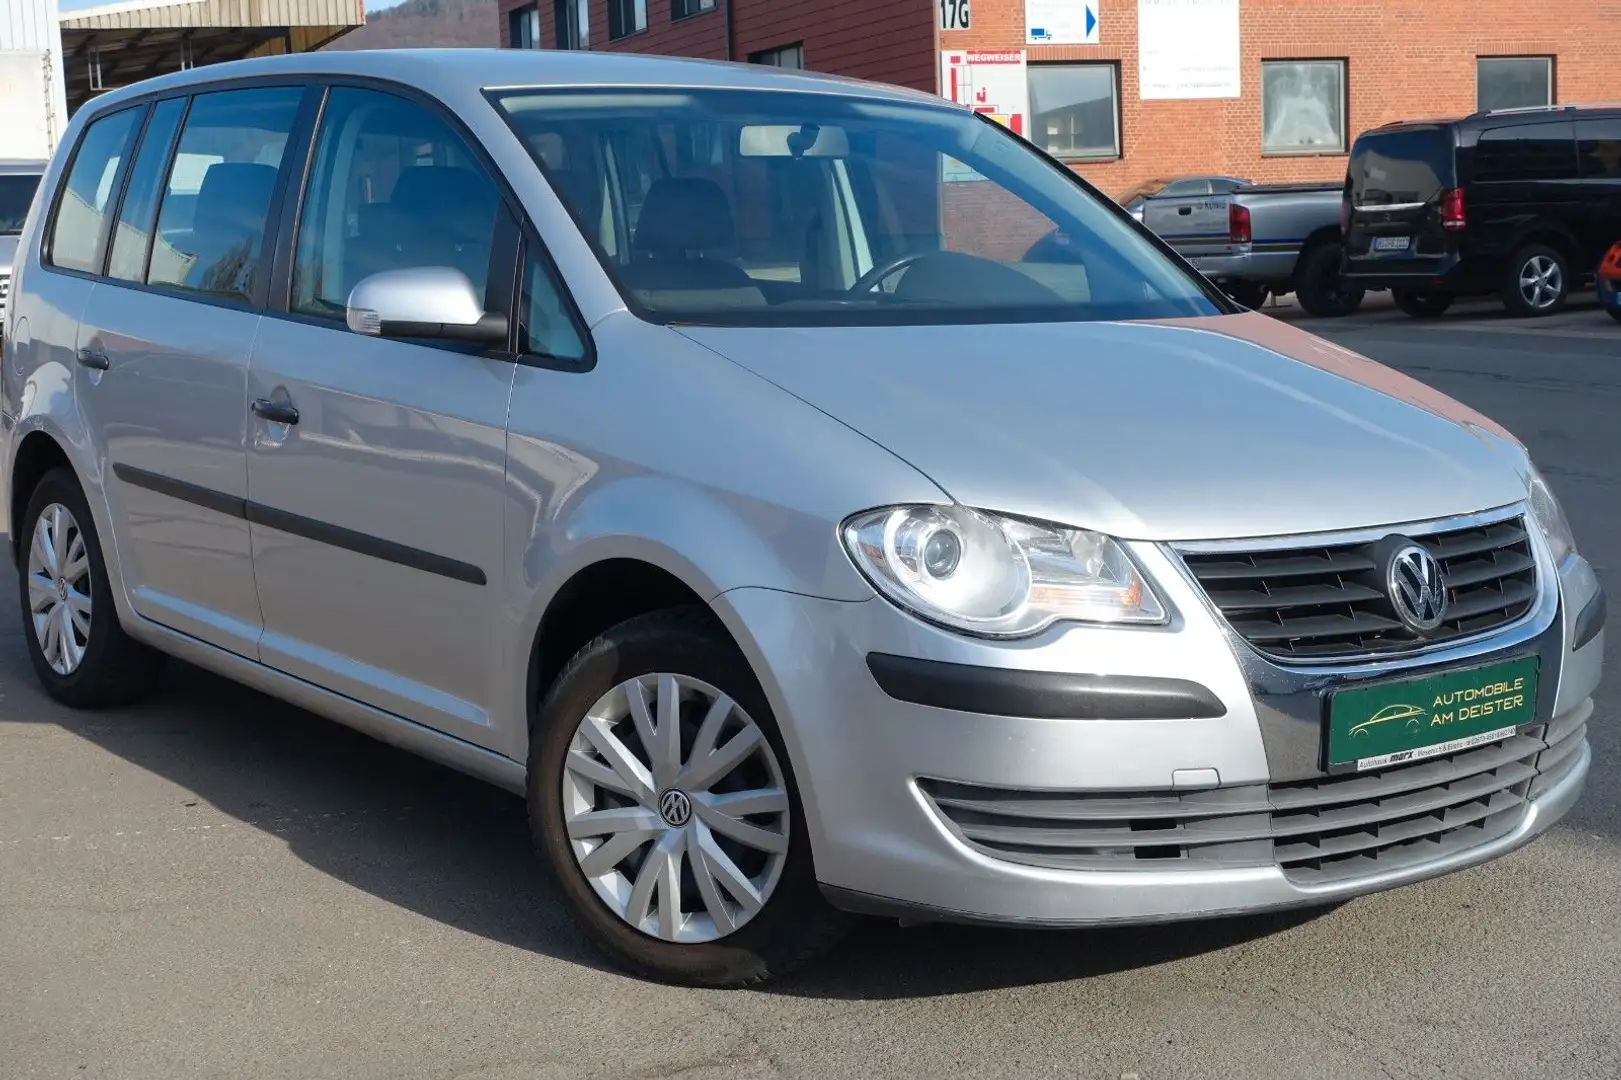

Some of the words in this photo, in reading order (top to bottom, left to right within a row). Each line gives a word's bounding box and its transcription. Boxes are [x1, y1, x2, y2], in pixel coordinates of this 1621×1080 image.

[940, 0, 969, 28] 17G
[966, 53, 1021, 62] WEGWEISER
[1432, 677, 1523, 708] AUTOMOBILE
[1430, 711, 1454, 727] AM
[1458, 694, 1523, 721] DEISTER
[1359, 757, 1387, 768] Autohaus
[1390, 751, 1414, 762] marx
